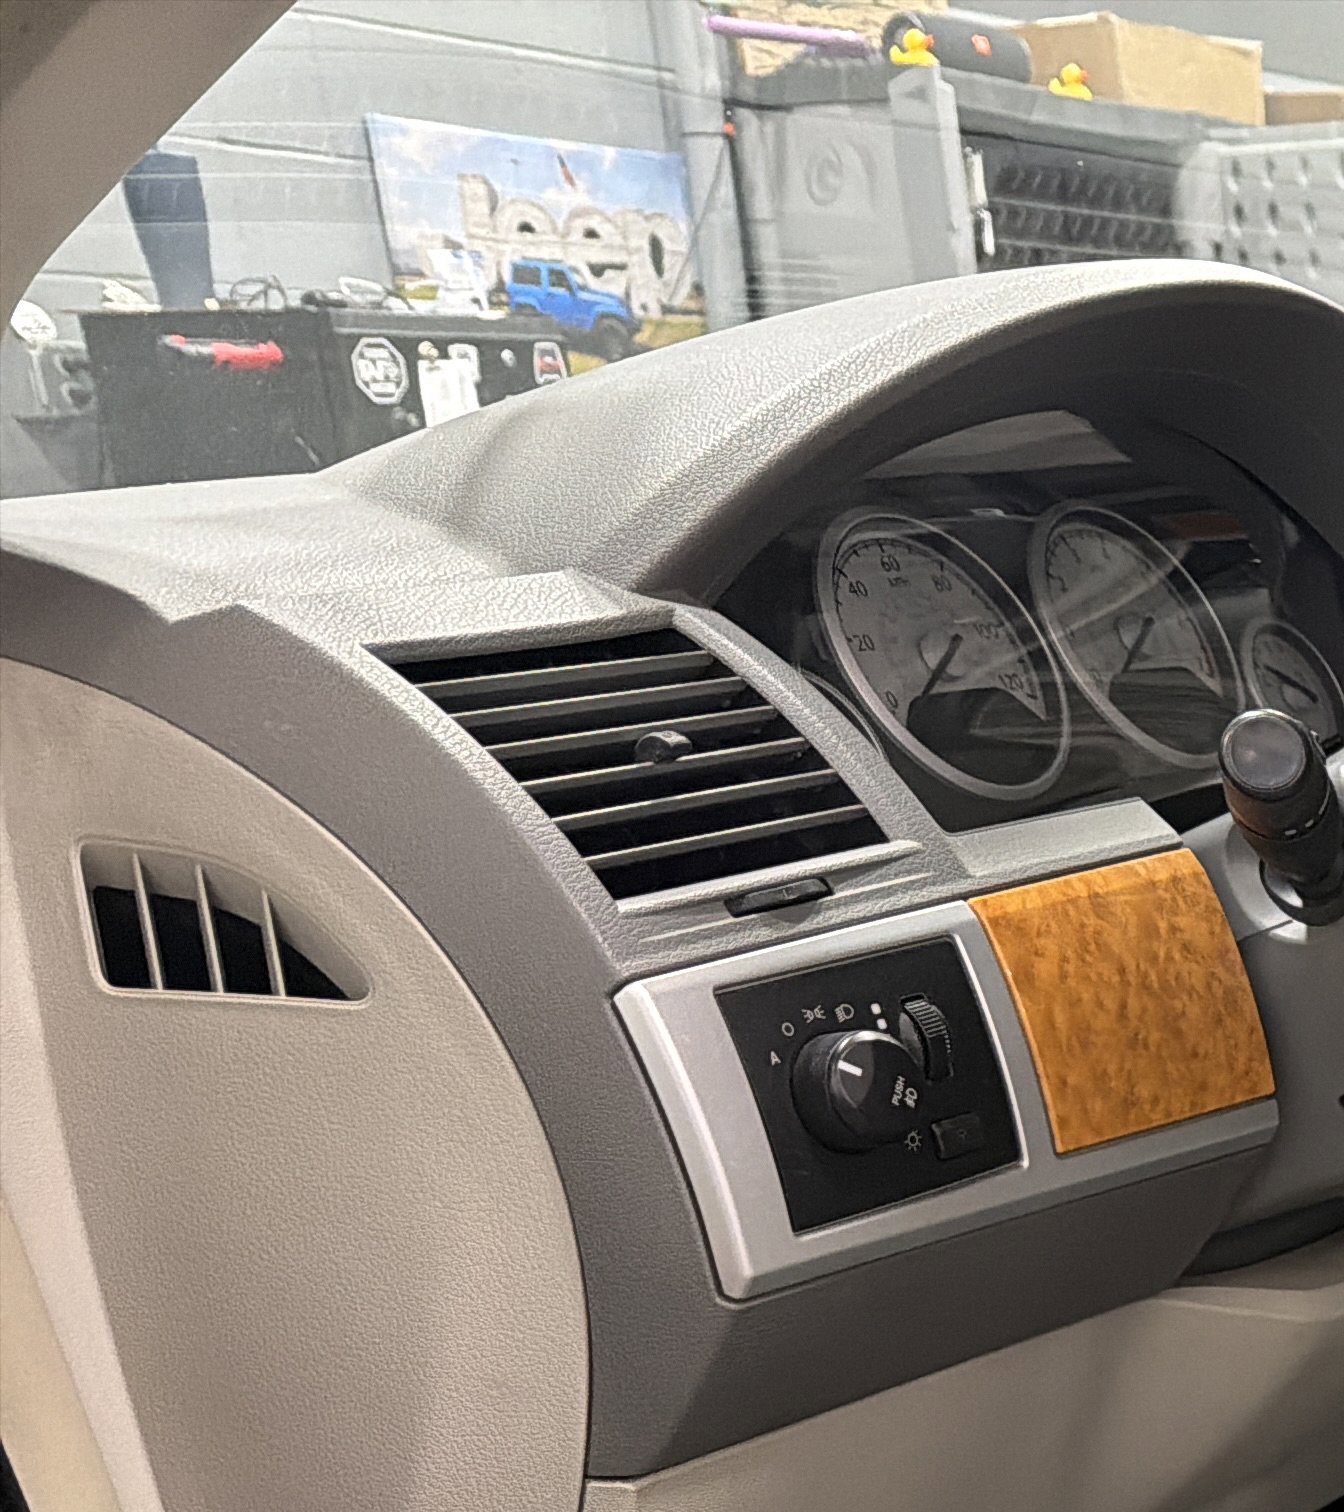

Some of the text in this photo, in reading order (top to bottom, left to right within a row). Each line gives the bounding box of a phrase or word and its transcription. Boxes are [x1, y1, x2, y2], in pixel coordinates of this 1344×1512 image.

[880, 555, 901, 573] 60
[848, 580, 869, 598] 40
[932, 574, 953, 592] 80
[856, 634, 876, 652] 20
[1000, 673, 1023, 690] 120
[886, 692, 898, 708] 0
[770, 1051, 781, 1066] A
[892, 1076, 905, 1106] PUSH
